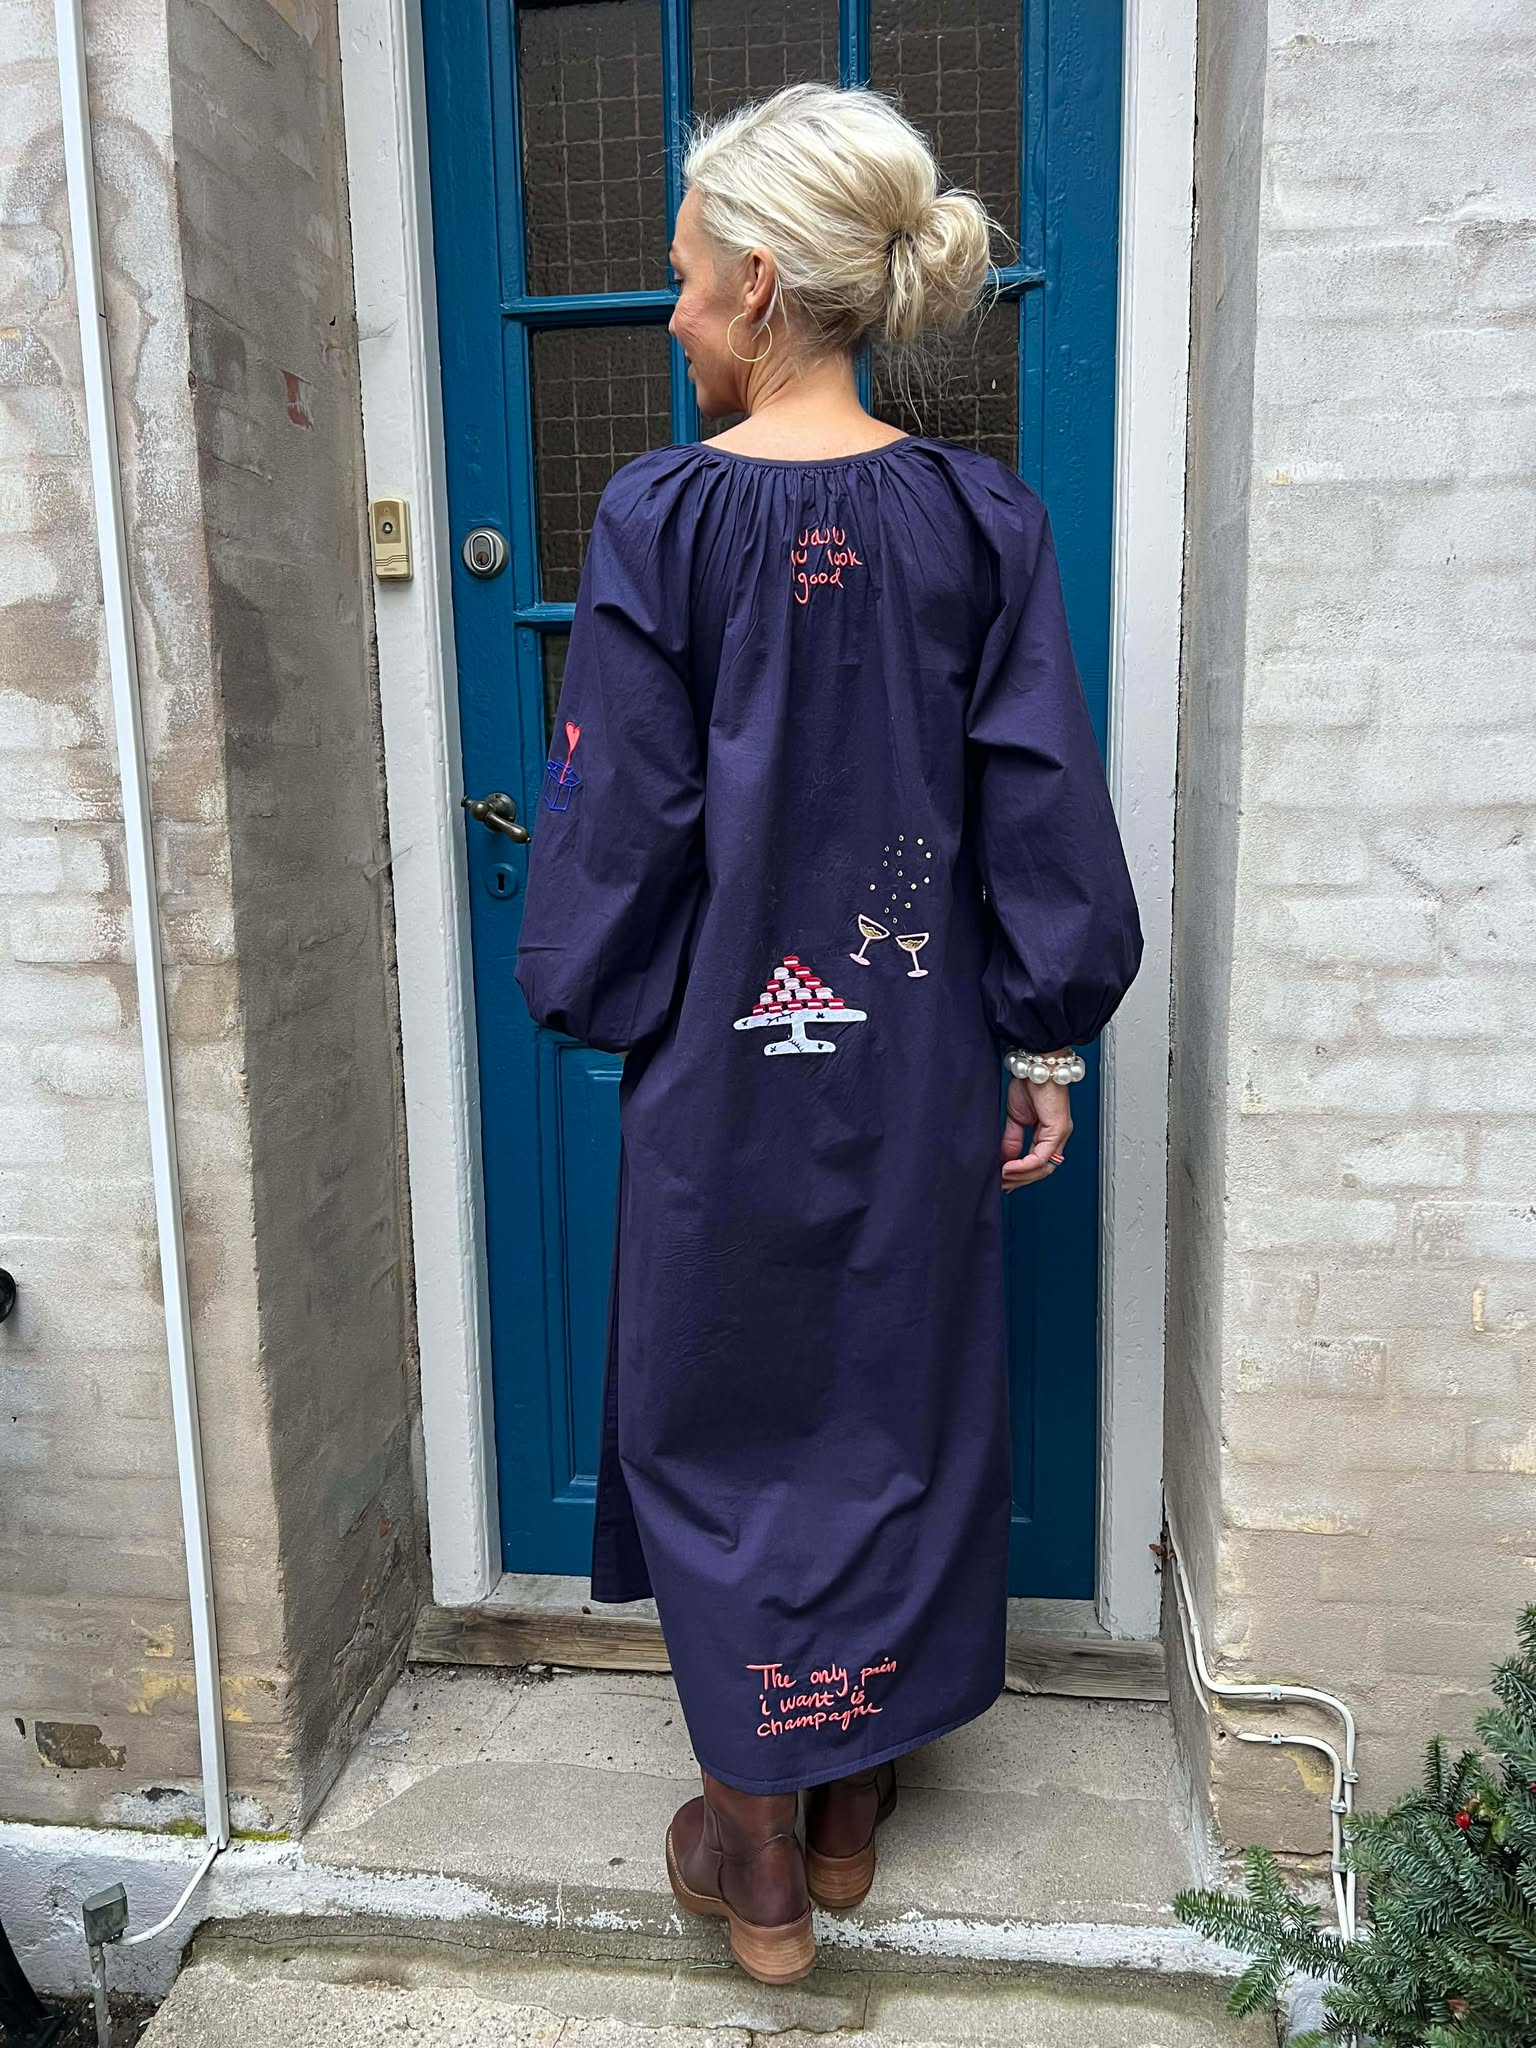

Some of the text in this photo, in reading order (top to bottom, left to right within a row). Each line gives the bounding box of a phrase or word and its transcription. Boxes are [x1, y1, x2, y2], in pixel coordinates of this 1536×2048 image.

[827, 547, 863, 567] look
[794, 567, 845, 604] good
[745, 1663, 797, 1691] The
[810, 1663, 849, 1697] only
[759, 1685, 866, 1716] i want is
[756, 1702, 883, 1737] champagne
